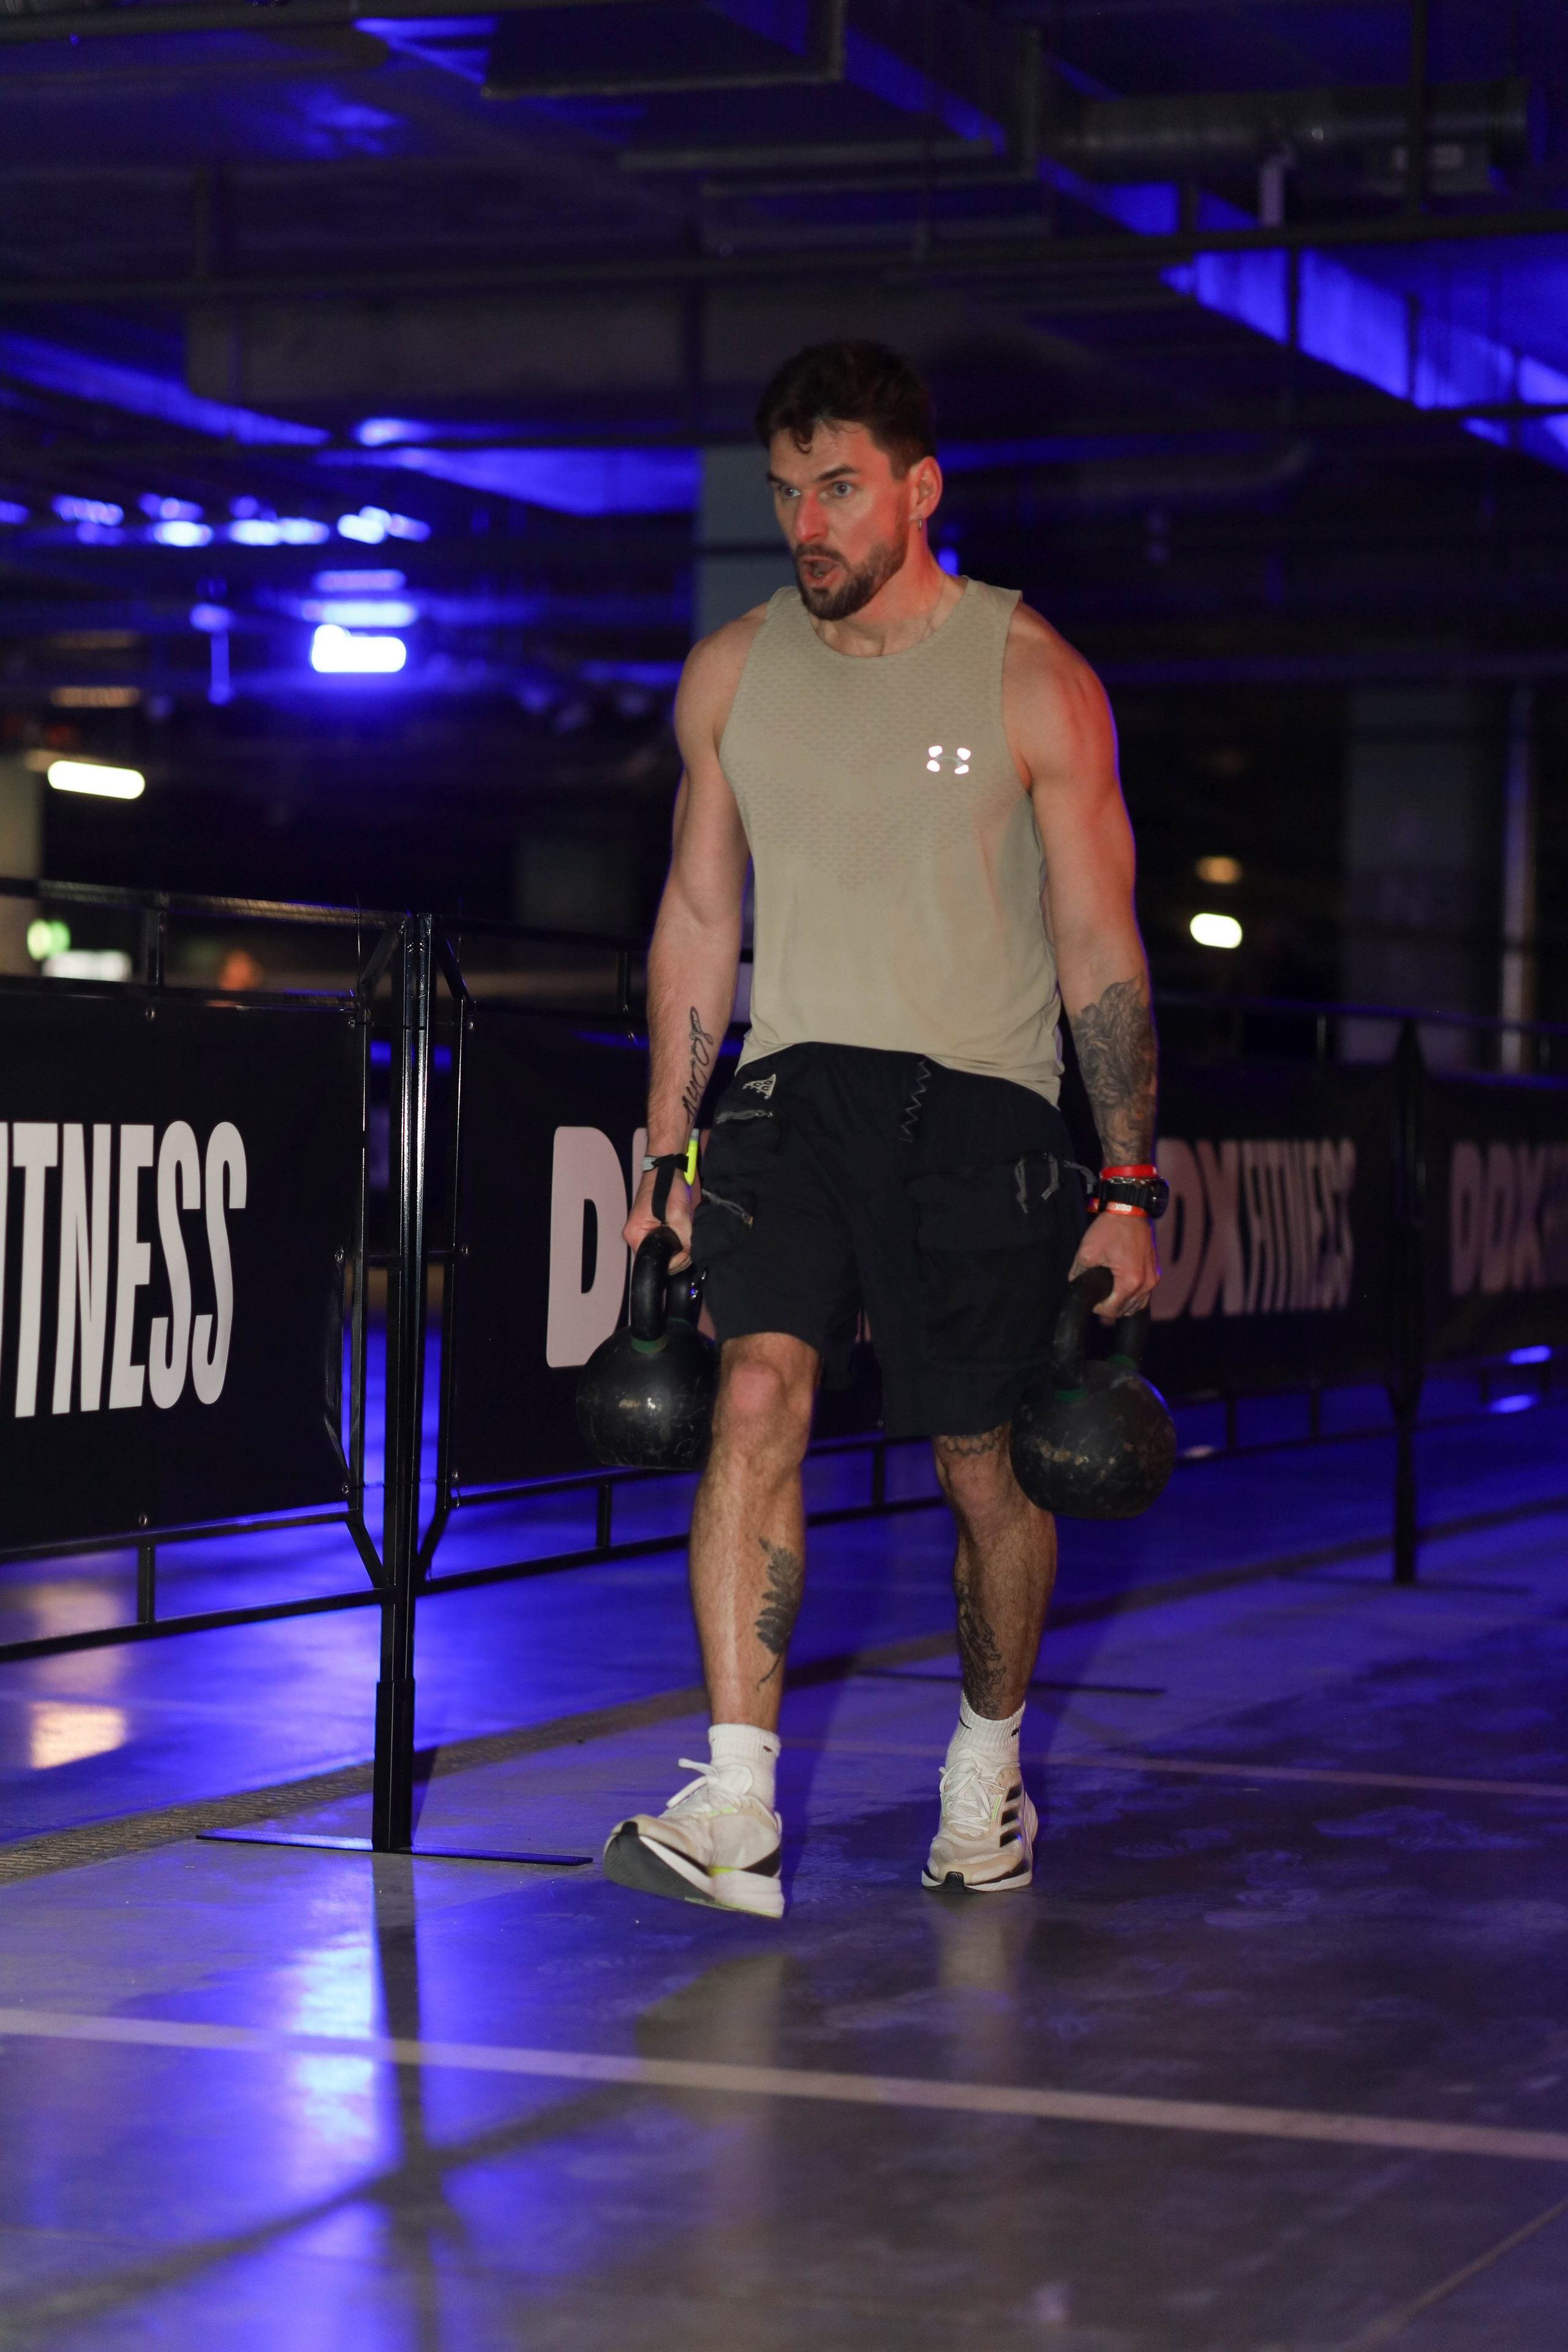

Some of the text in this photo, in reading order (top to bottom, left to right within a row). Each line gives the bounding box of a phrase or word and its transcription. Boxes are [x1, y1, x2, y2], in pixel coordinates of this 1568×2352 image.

[0, 1120, 247, 1418] TNESS
[1098, 1136, 1245, 1327] DX
[1242, 1137, 1357, 1315] FITNESS
[1449, 1139, 1546, 1295] DDX
